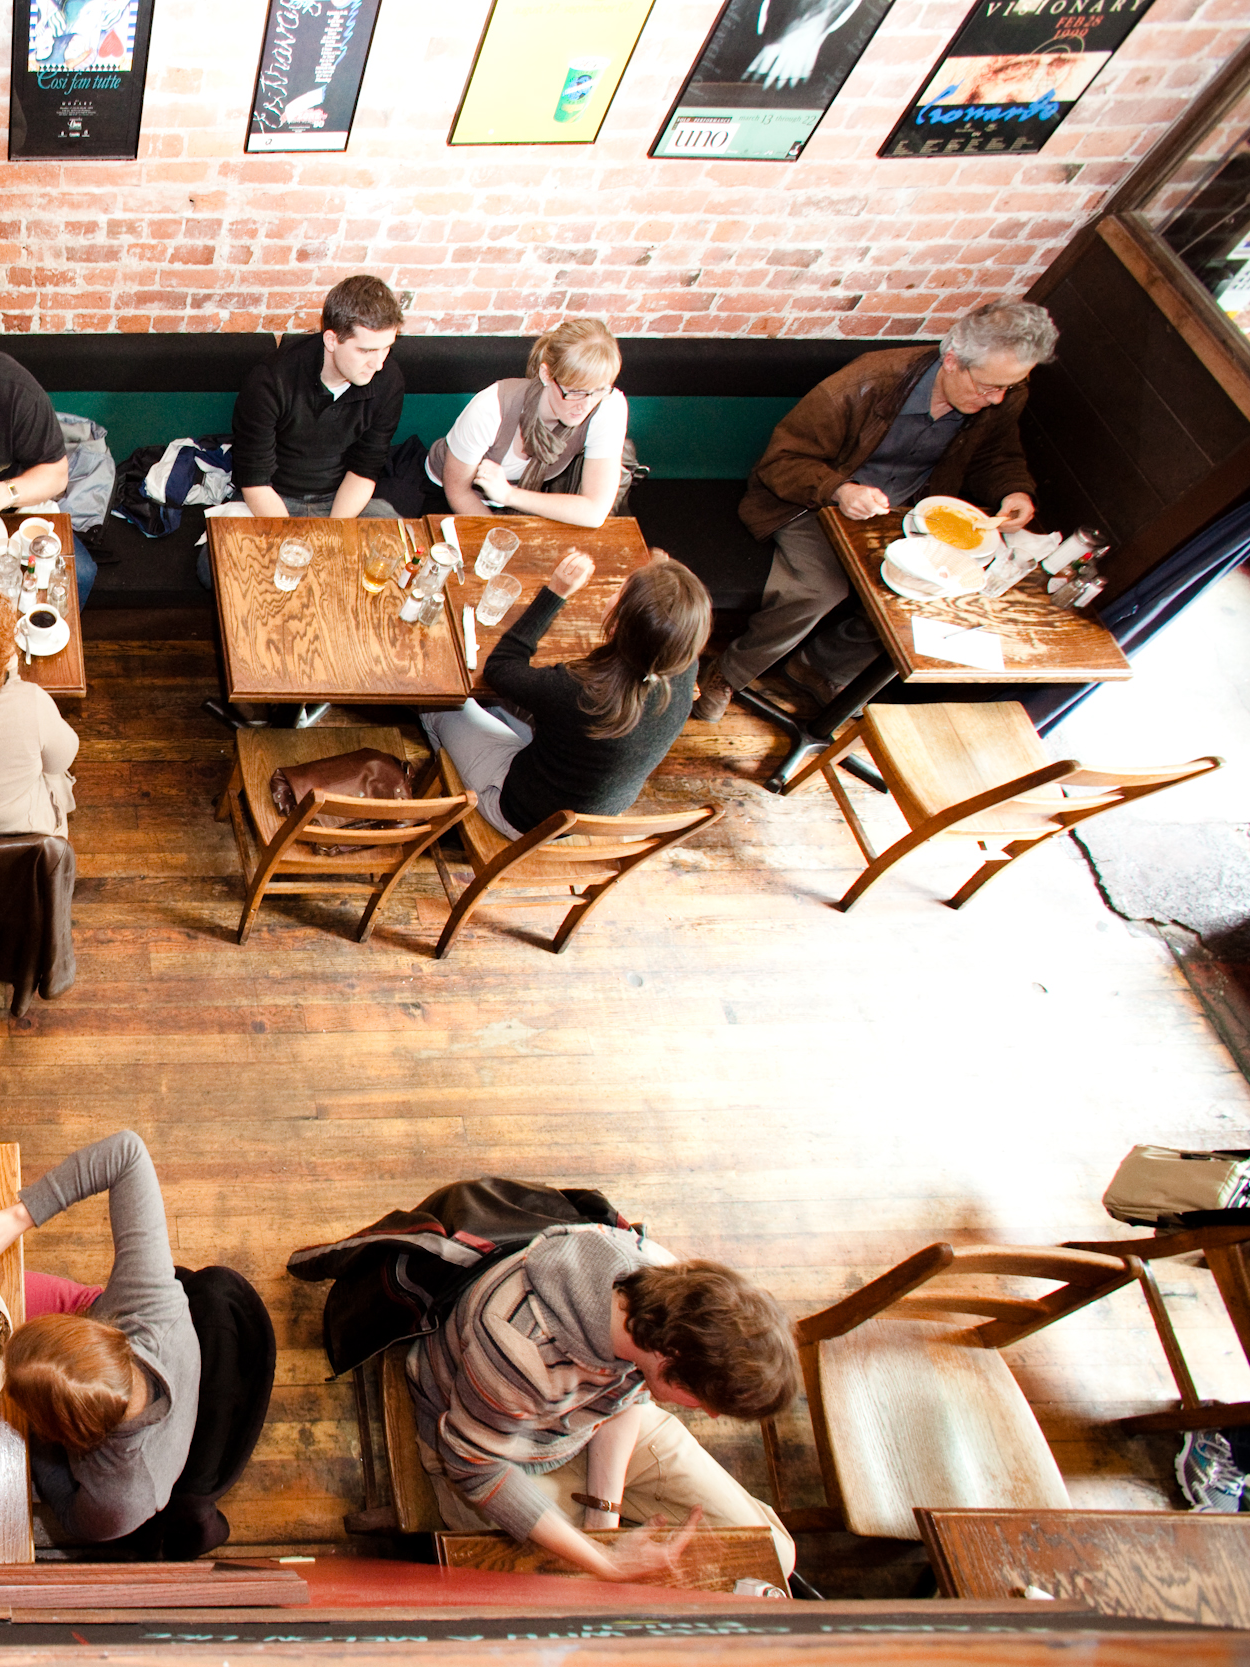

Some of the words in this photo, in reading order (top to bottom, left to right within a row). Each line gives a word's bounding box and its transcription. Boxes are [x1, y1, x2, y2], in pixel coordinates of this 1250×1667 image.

[986, 0, 1143, 17] VISIONARY
[1055, 15, 1086, 28] FEB
[64, 72, 92, 95] fan
[92, 75, 122, 90] tutte
[761, 114, 774, 125] 13
[802, 115, 817, 126] 22
[675, 130, 729, 147] uno
